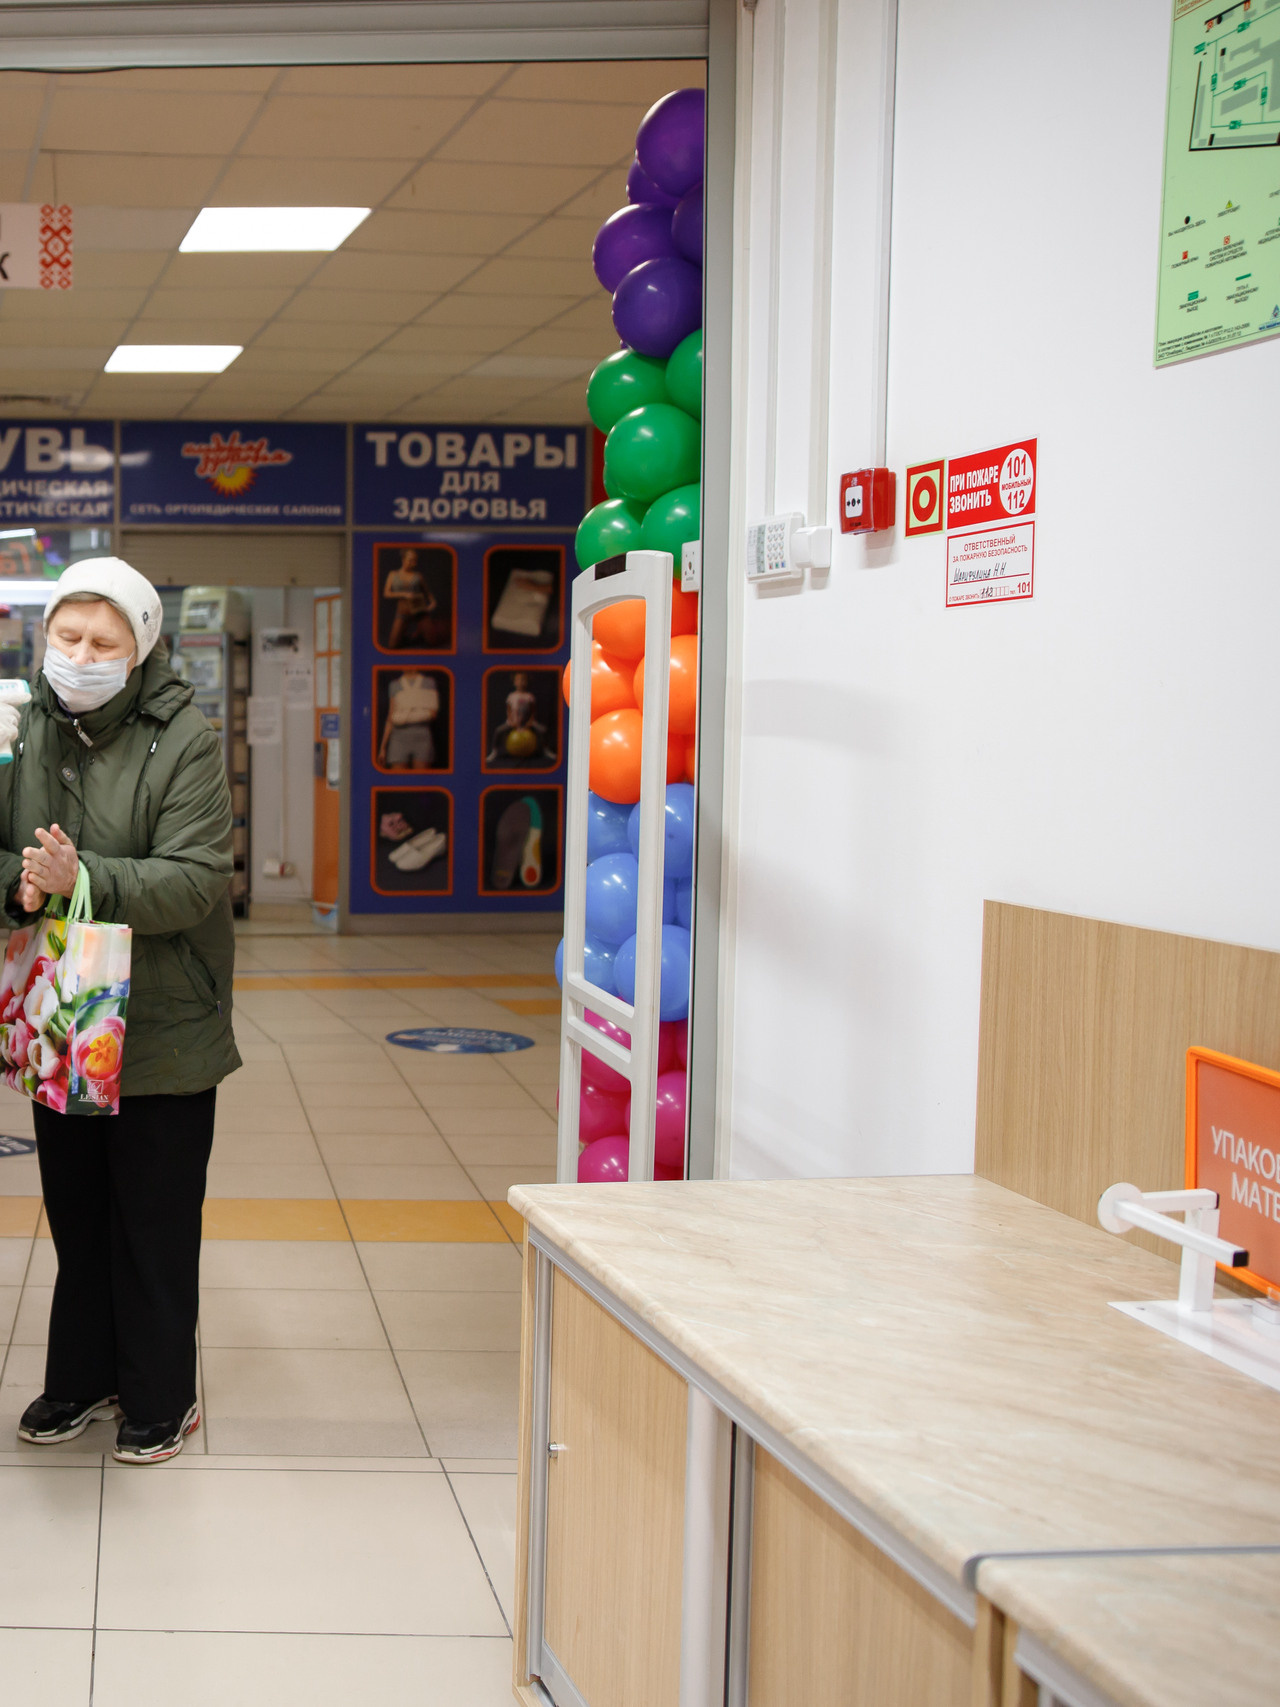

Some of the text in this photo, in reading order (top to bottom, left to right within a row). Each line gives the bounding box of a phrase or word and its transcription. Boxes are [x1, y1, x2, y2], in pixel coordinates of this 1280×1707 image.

[366, 432, 577, 468] ТОВАРЫ
[1007, 453, 1027, 479] 101
[441, 472, 500, 494] ДЛЯ
[949, 465, 999, 494] ПРИ ПОЖАРЕ
[1001, 477, 1031, 491] МОБИЛЬНЫЙ
[130, 504, 162, 515] СЕТЬ
[283, 505, 342, 515] САЛОНОВ
[394, 499, 546, 521] ЗДОРОВЬЯ
[949, 489, 992, 514] ЗВОНИТЬ
[1008, 489, 1025, 510] 112
[960, 551, 987, 562] ПОЖАРНУЮ
[988, 544, 1028, 558] БЕЗОПАСНОСТЬ
[963, 534, 1016, 552] ОТВЕТСТВЕННЫЙ
[1017, 581, 1031, 594] 101
[1232, 1171, 1280, 1223] МАТЕ
